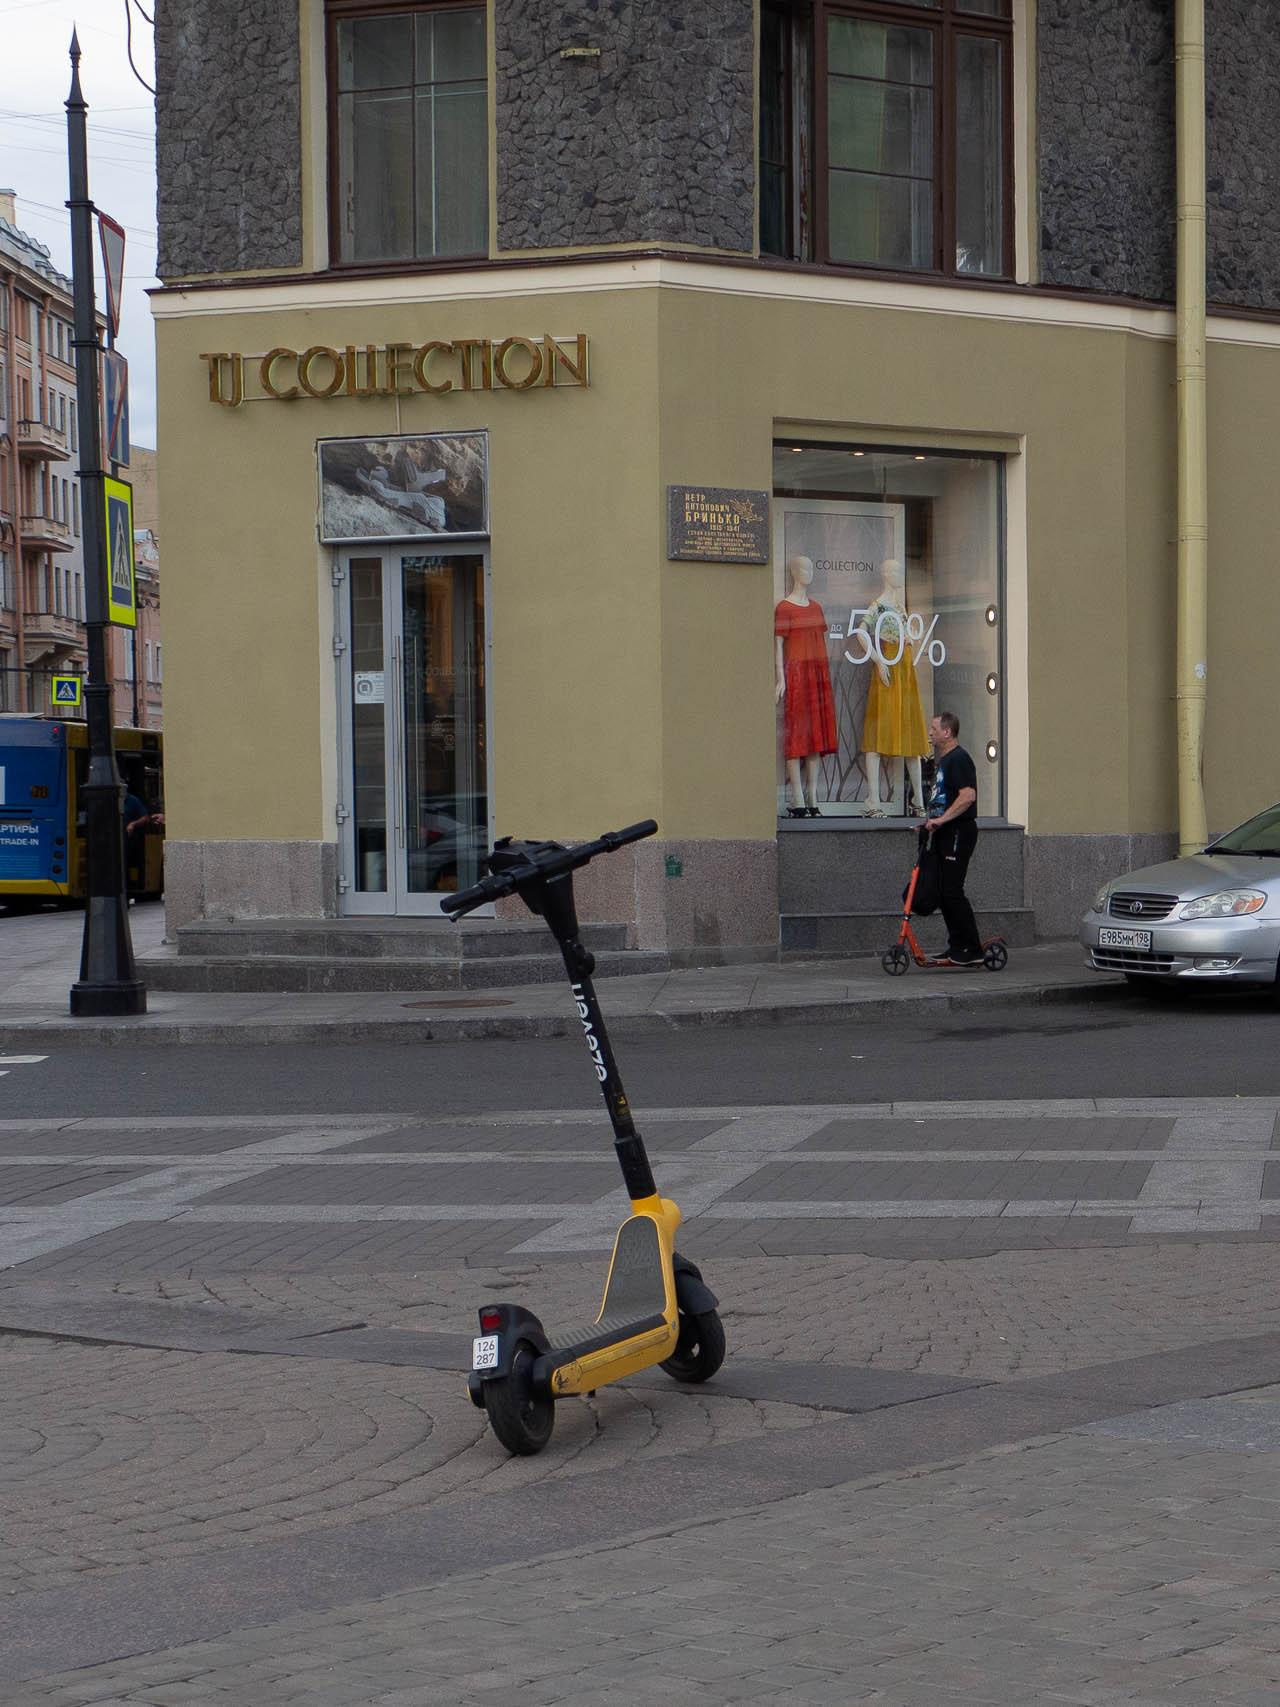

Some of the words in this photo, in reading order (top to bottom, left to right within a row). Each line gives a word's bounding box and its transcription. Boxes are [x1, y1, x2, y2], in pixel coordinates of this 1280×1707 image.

[259, 333, 589, 400] COLLECTION
[685, 511, 740, 525] БРИНЬКО
[815, 559, 874, 573] COLLECTION
[0, 825, 39, 834] РТИРЫ
[0, 838, 39, 846] TRADE-IN
[1135, 932, 1149, 943] 198
[477, 1340, 495, 1352] 126
[477, 1353, 495, 1365] 287
